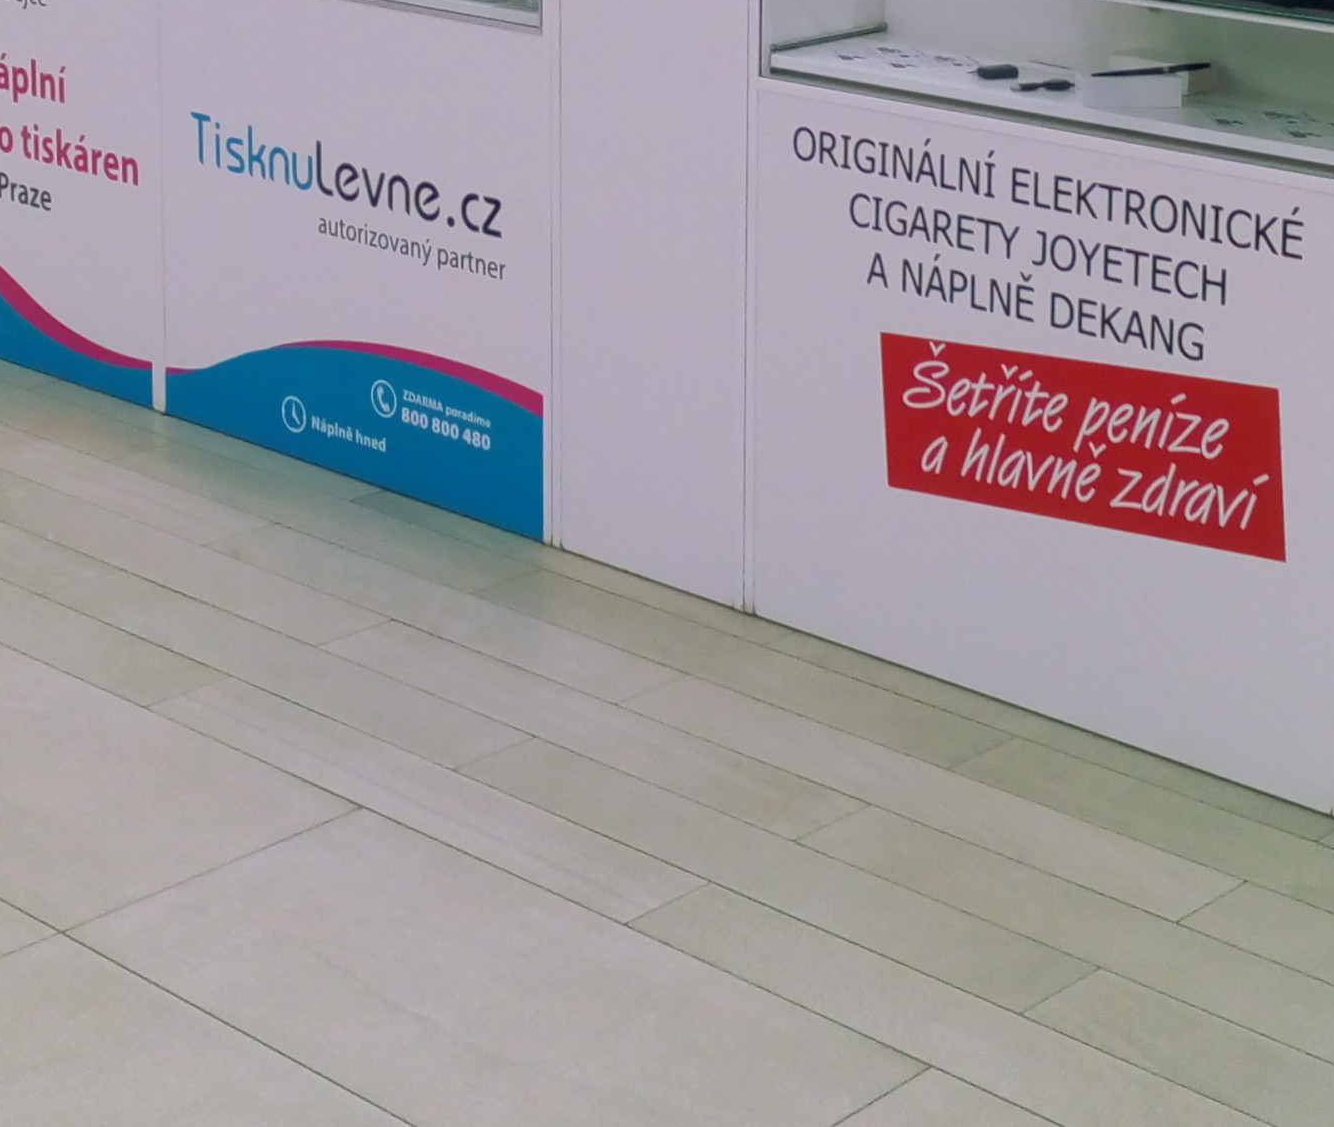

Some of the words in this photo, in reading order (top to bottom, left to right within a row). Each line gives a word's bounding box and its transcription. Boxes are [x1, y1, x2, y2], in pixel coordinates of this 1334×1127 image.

[21, 123, 139, 187] tiskáren
[190, 111, 503, 239] TisknuLevne.cz
[792, 126, 997, 200] ORIGINÁLNÍ
[1010, 166, 1305, 260] ELEKTRONICKÉ
[317, 217, 432, 267] autorizovaný
[436, 245, 506, 280] partner
[849, 192, 1021, 261] CIGARETY
[1032, 230, 1228, 307] JOYETECH
[866, 251, 889, 289] A
[901, 253, 1036, 323] NÁPLNĚ
[1050, 292, 1205, 362] DEKANG
[311, 415, 353, 443] Náplně
[355, 435, 388, 453] hned
[401, 406, 429, 430] 800
[431, 417, 460, 440] 800
[462, 428, 492, 451] 480
[402, 388, 444, 413] ZDARMA
[902, 341, 1069, 432] Šetříte
[1073, 393, 1230, 461] peníze
[921, 435, 949, 475] a
[961, 426, 1107, 504] hlavně
[1109, 463, 1271, 531] zdraví
